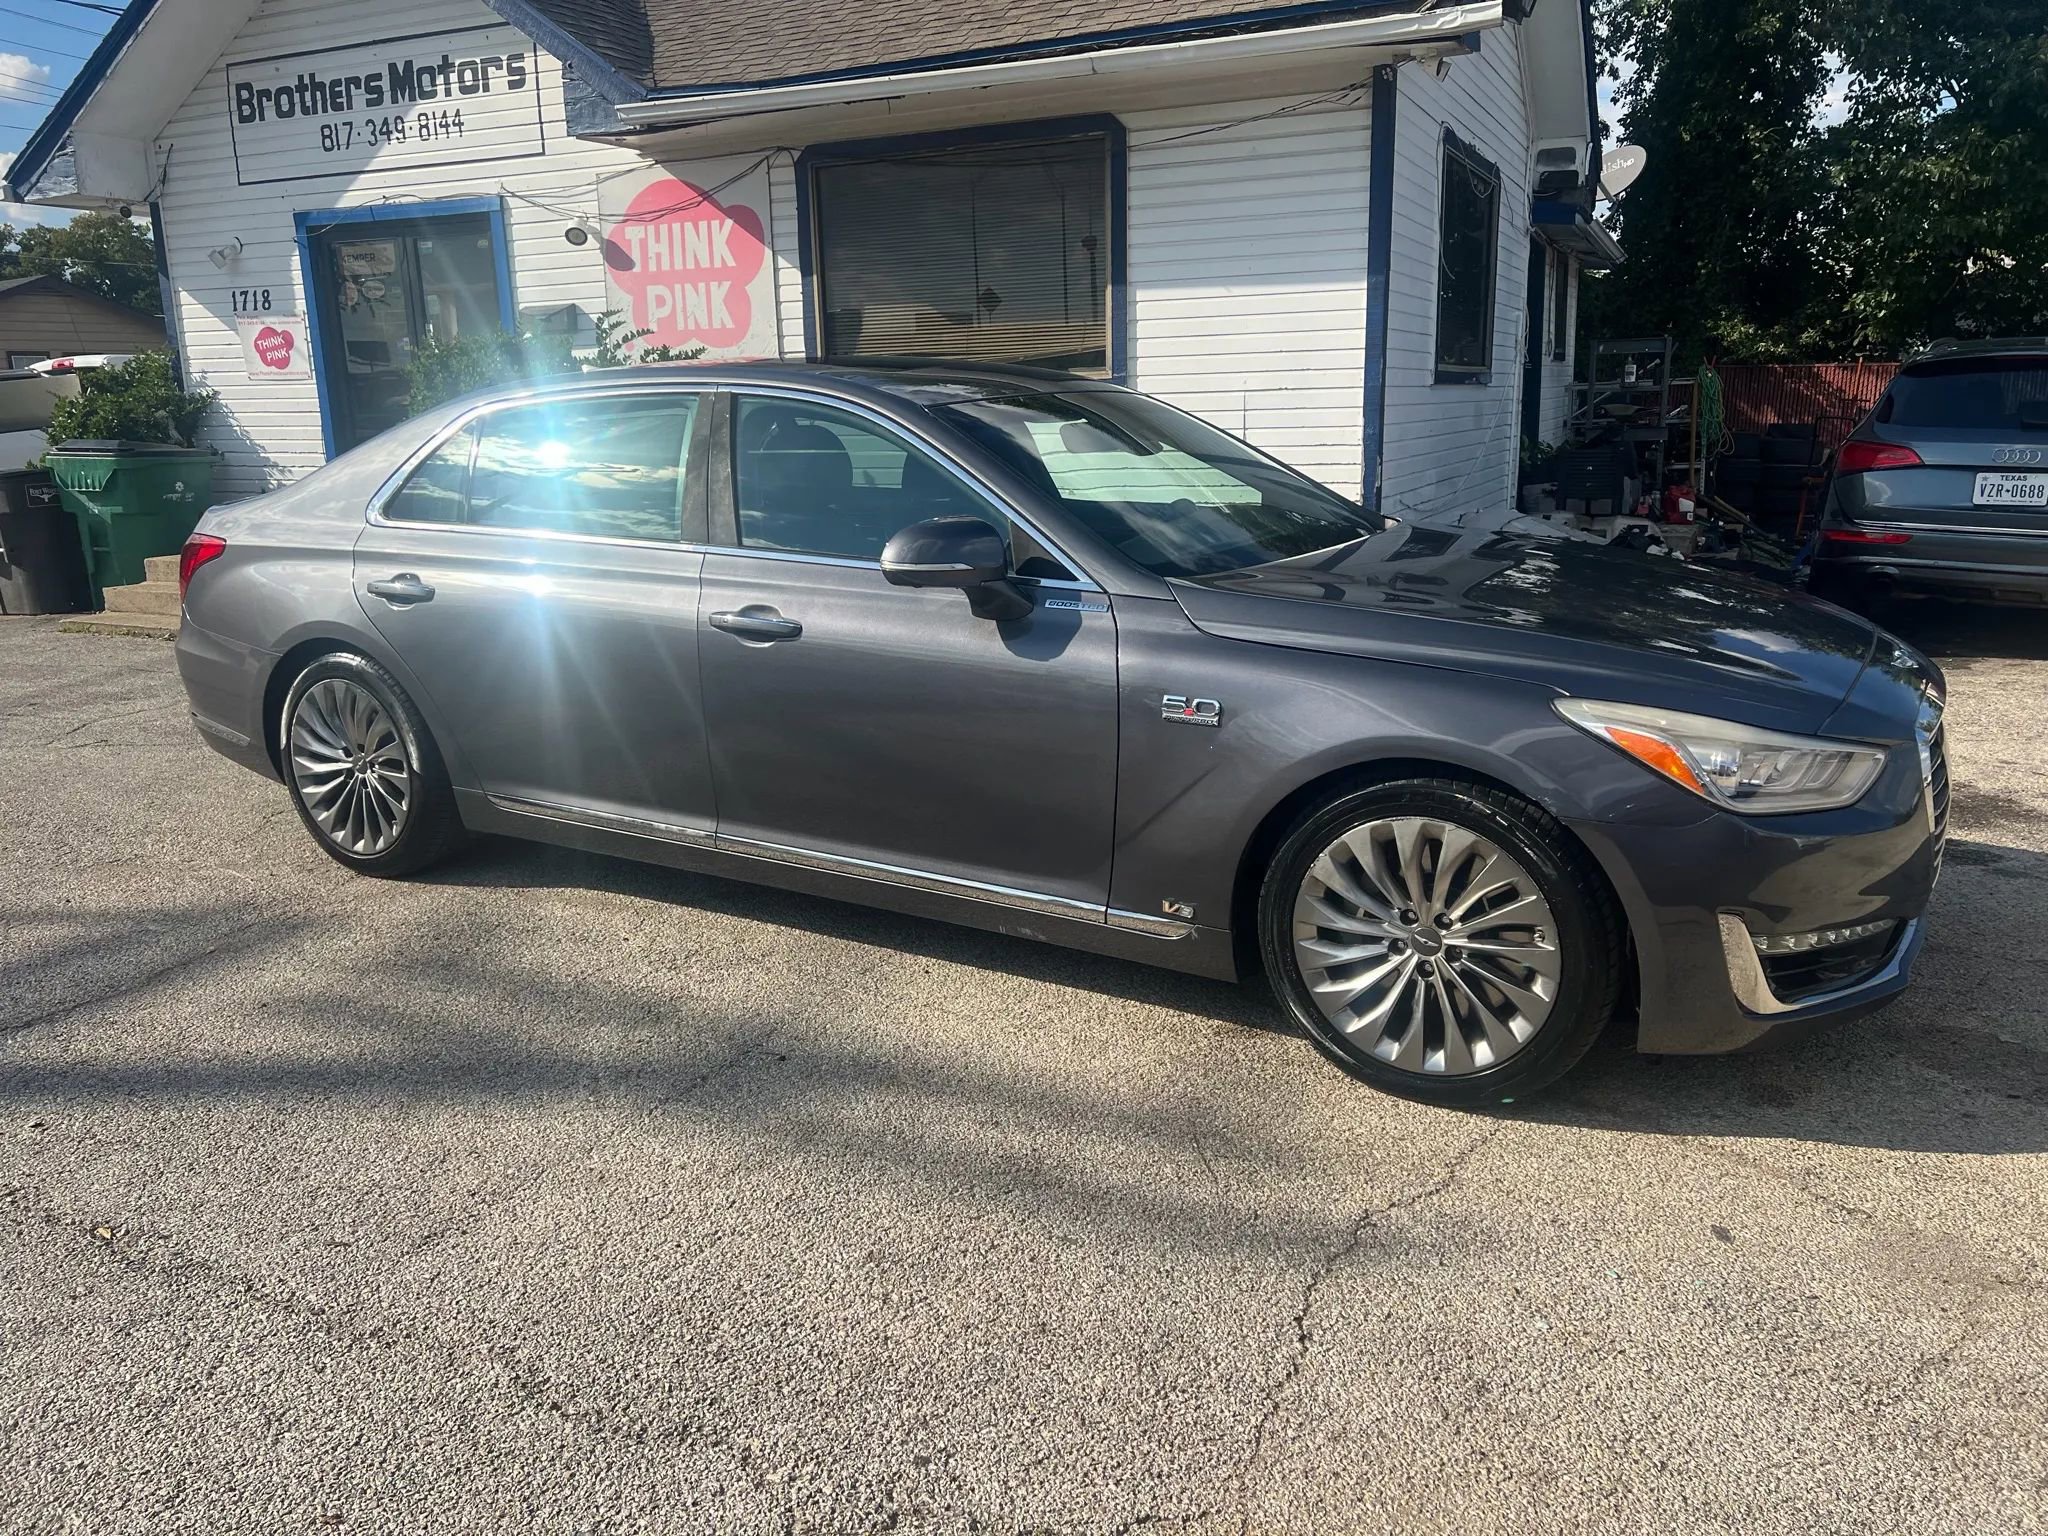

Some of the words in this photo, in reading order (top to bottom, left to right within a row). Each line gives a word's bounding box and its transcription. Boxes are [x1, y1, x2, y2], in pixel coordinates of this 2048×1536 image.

[235, 71, 384, 125] Brothers
[387, 52, 528, 105] Motors
[623, 217, 737, 273] THINK
[231, 288, 272, 312] 1718
[645, 280, 736, 332] PINK
[256, 334, 286, 351] THINK
[266, 347, 289, 362] PINK
[2000, 474, 2028, 482] TEXAS
[1048, 600, 1105, 610] BOOSTED
[1161, 694, 1221, 716] 5.0
